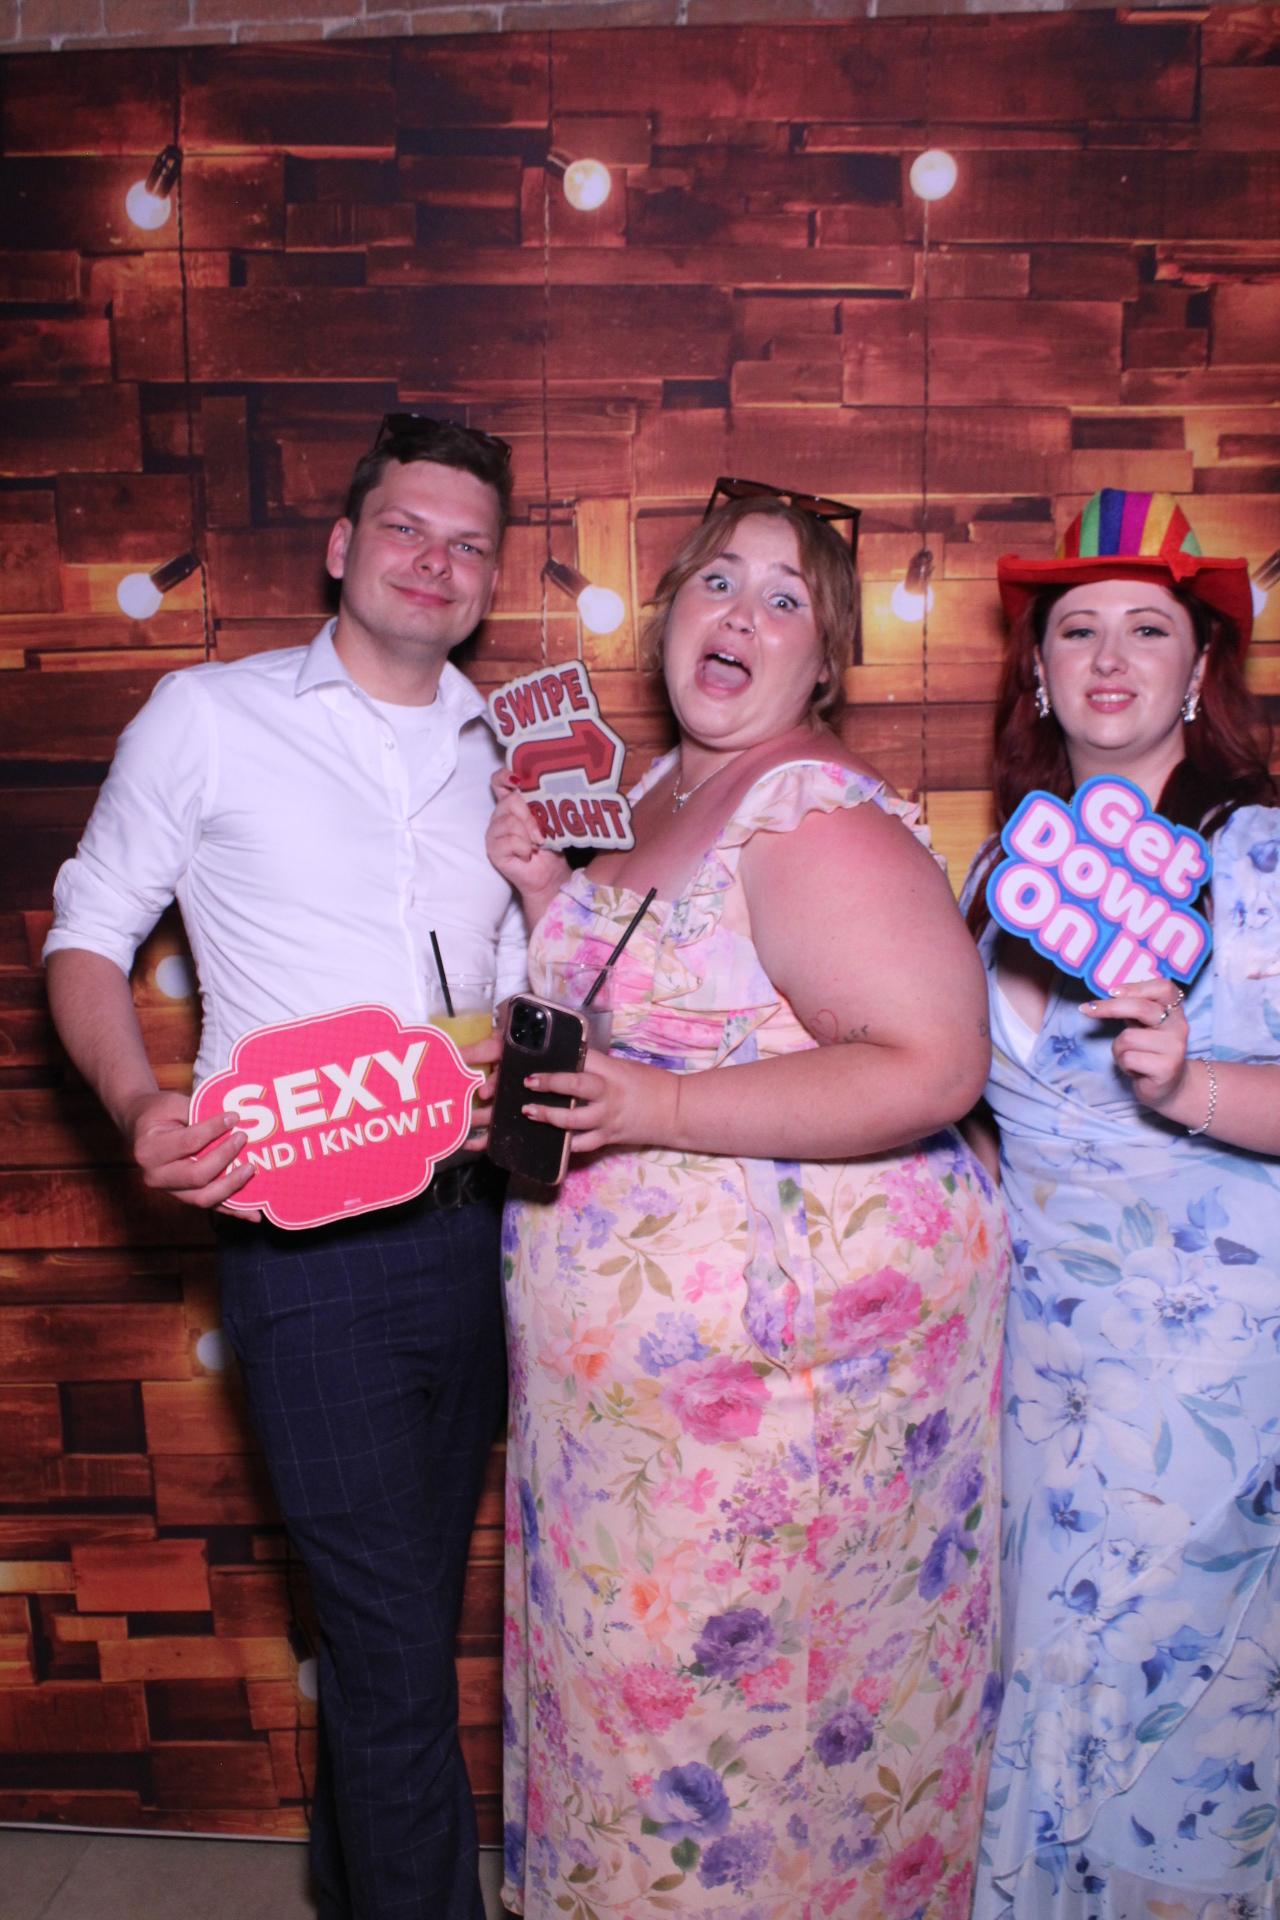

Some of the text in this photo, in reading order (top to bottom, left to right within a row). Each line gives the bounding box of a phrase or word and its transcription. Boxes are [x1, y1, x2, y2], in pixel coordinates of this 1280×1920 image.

[494, 668, 590, 737] SWIPE
[527, 798, 627, 840] RIGHT
[1082, 784, 1204, 900] Get
[997, 864, 1096, 966] On
[1011, 800, 1202, 973] Down
[222, 1041, 429, 1145] SEXY
[302, 1136, 314, 1161] I
[319, 1108, 420, 1156] KNOW
[427, 1099, 454, 1129] IT
